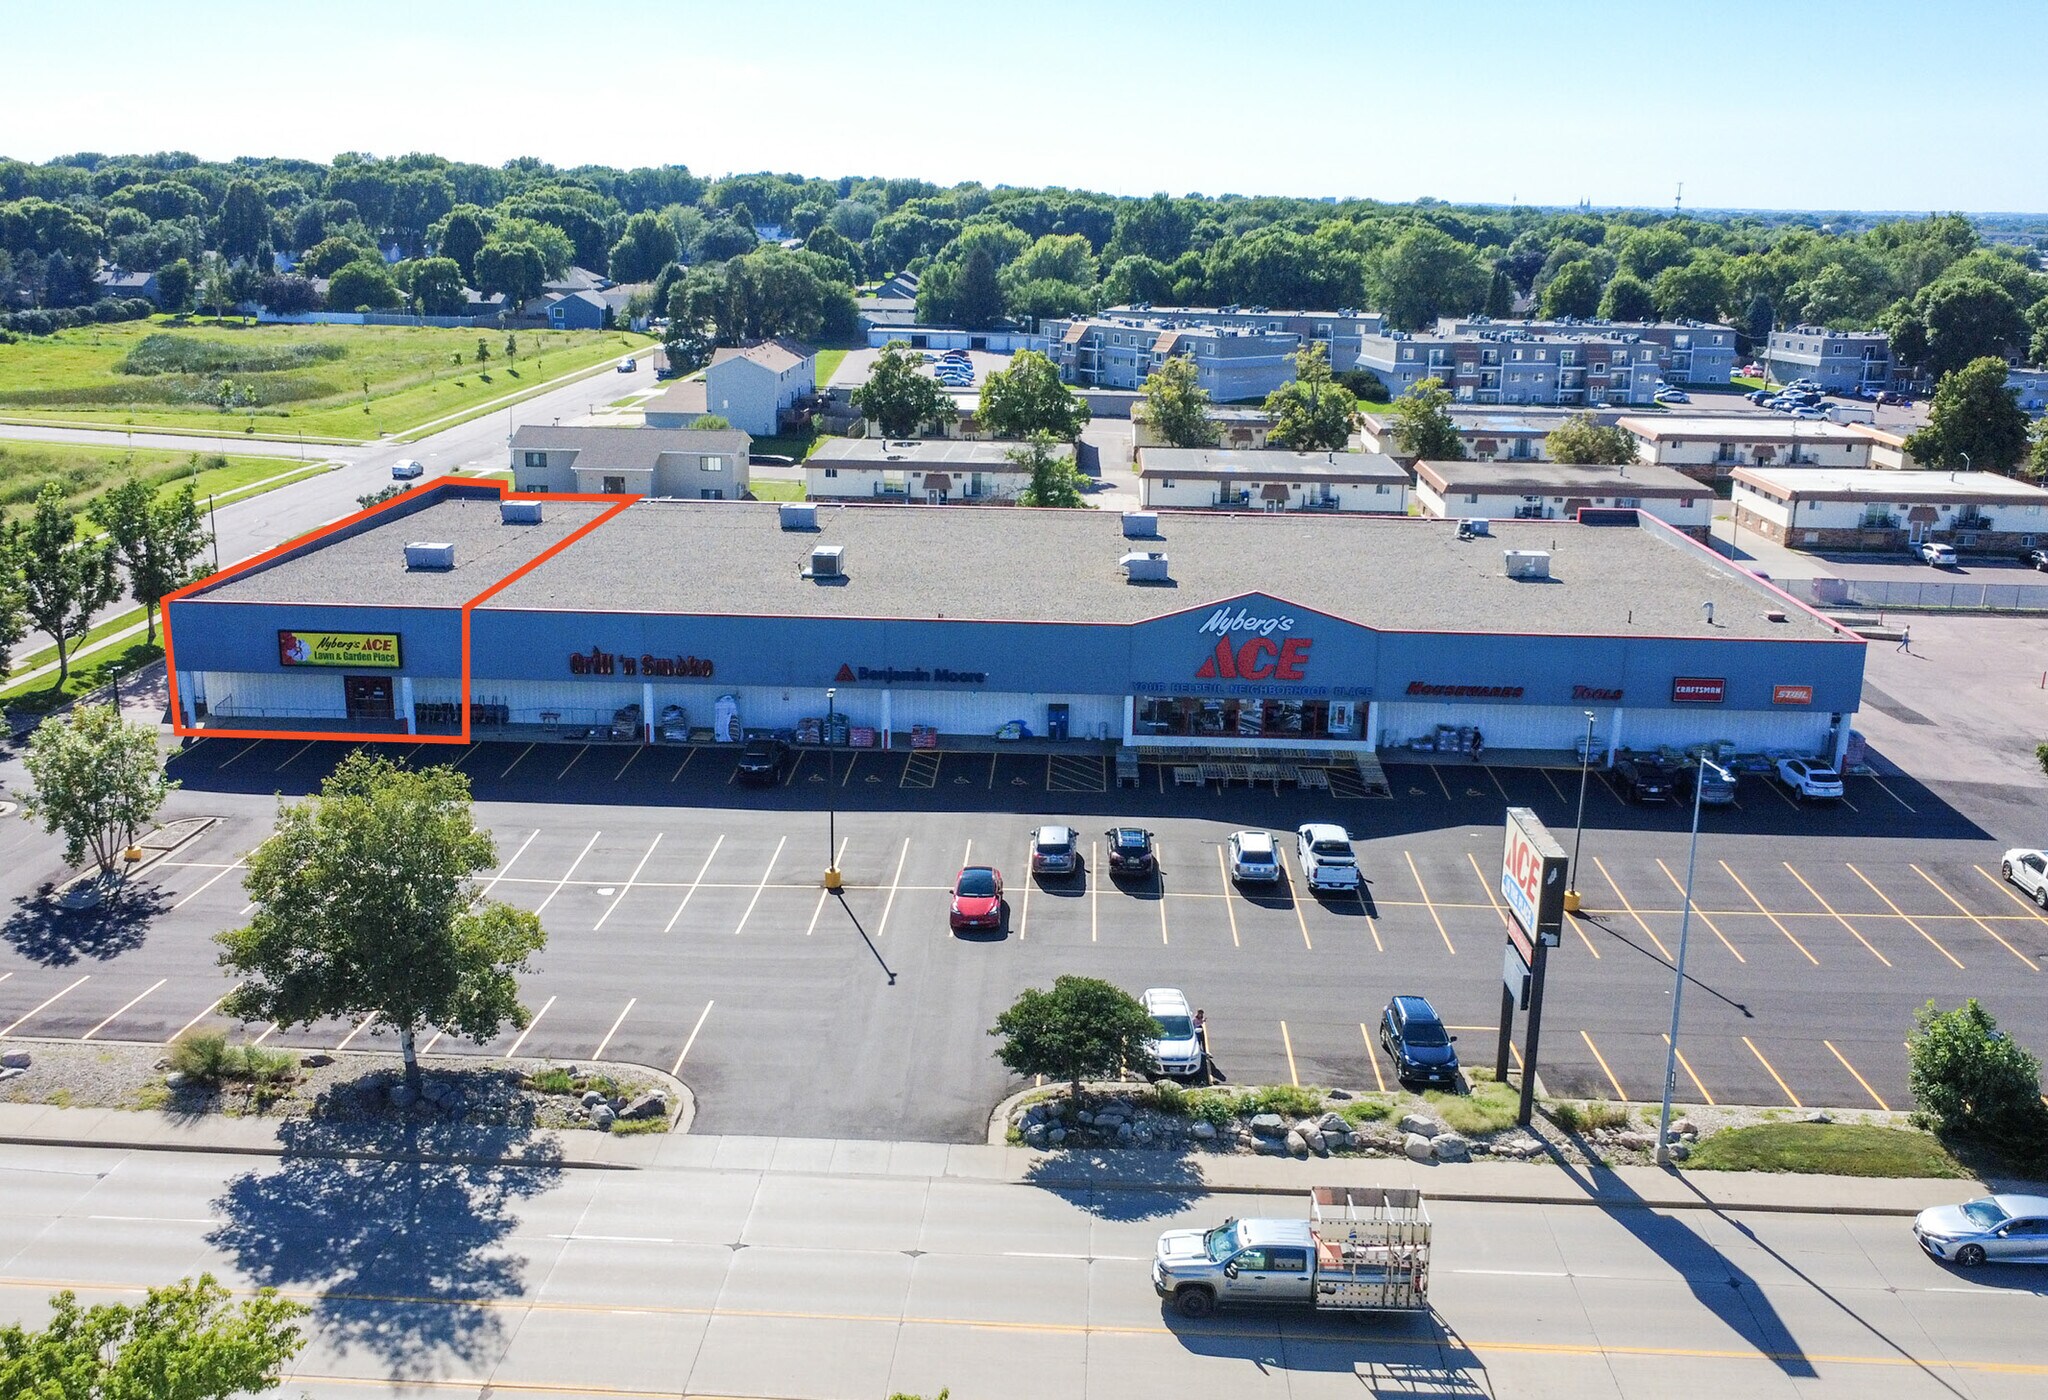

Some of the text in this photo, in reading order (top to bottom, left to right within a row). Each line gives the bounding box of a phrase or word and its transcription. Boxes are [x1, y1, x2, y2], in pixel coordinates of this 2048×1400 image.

[1199, 606, 1295, 636] Nyberg's
[317, 636, 392, 651] Nyberg's ACE
[314, 651, 396, 662] Lawn & Garden Place
[570, 646, 614, 675] Grill
[641, 654, 714, 677] Smoke
[1195, 635, 1313, 681] ACE
[858, 666, 985, 684] Benjamin Moore
[1132, 681, 1373, 697] YOUR HELPFUL NEIGHBORHOOD PLACE
[1676, 686, 1722, 694] CRAFTSMAN
[1777, 690, 1809, 699] STIHL
[1506, 830, 1540, 904] ACE
